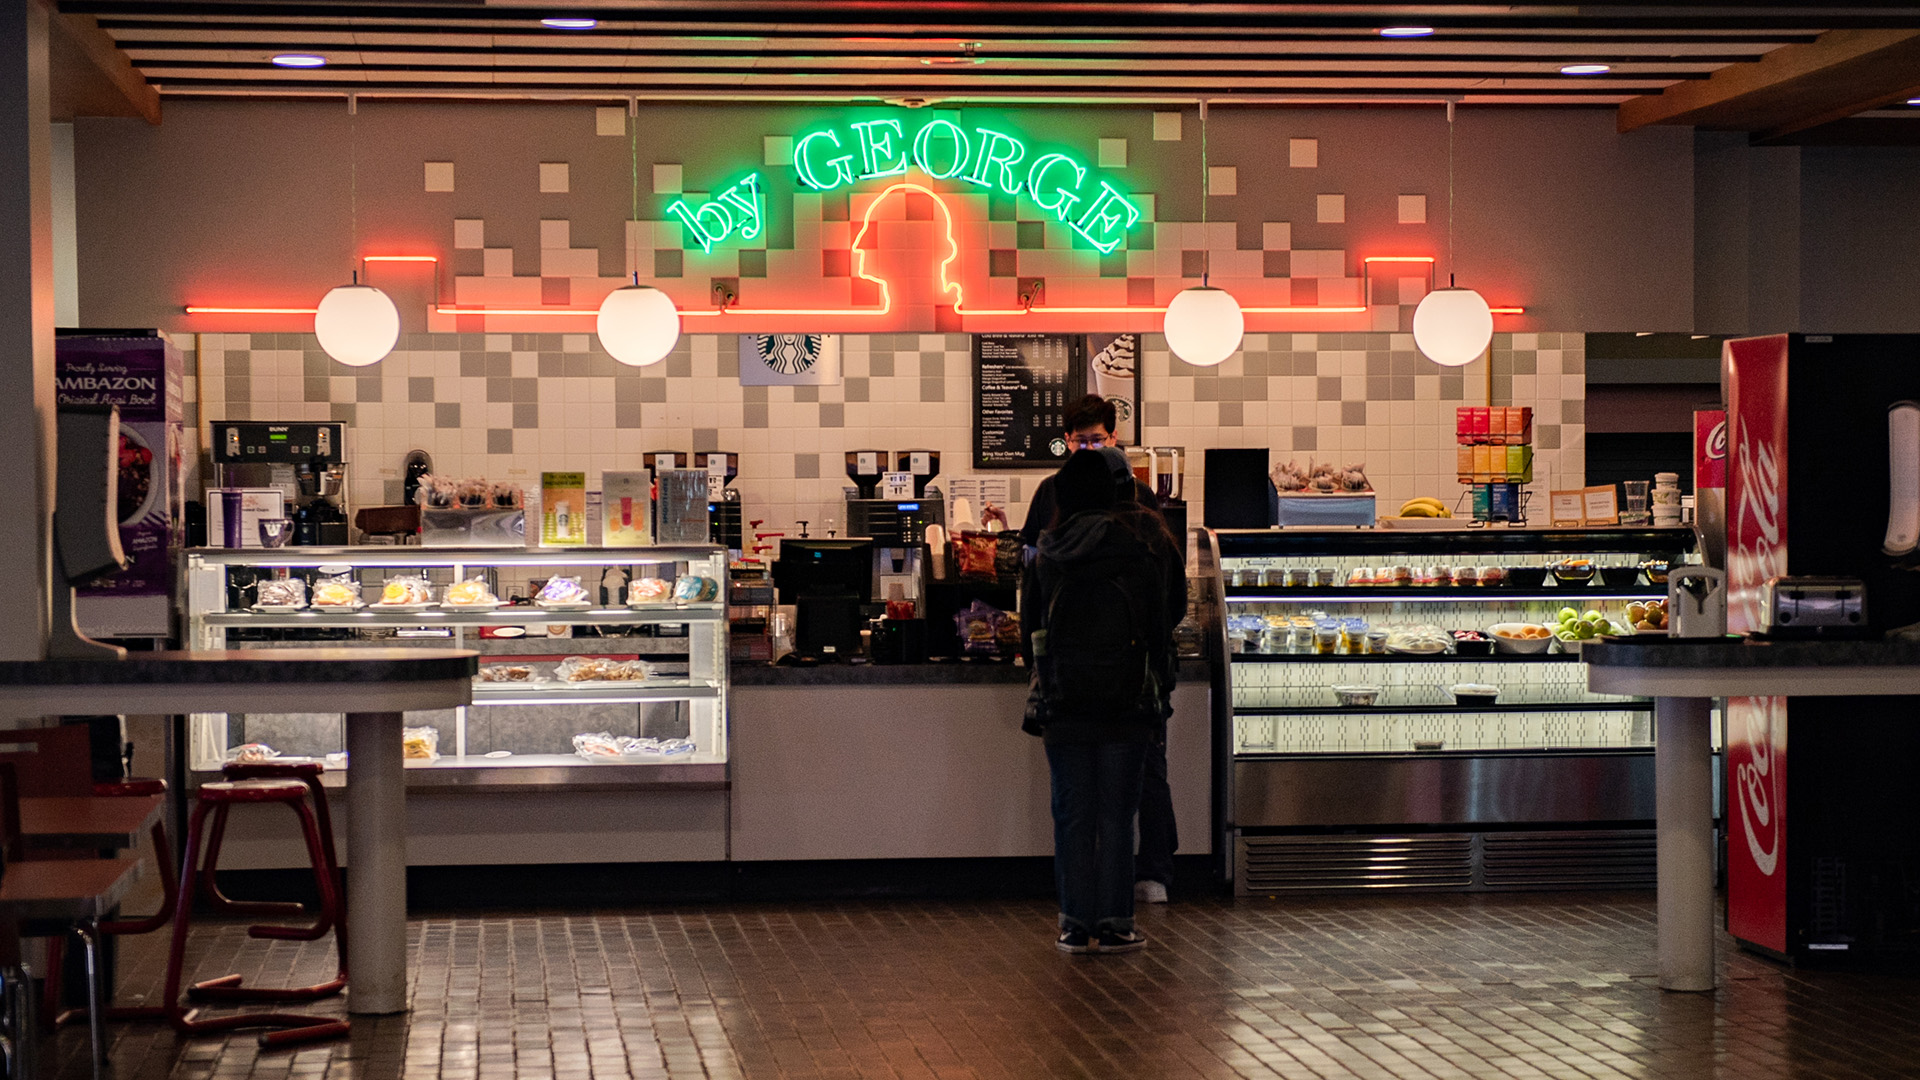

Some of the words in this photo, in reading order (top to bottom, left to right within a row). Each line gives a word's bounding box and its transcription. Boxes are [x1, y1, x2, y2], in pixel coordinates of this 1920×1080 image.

[666, 171, 759, 254] by
[792, 118, 1140, 254] GEORGE
[98, 362, 128, 375] Serving
[56, 377, 157, 390] AMBAZON
[128, 392, 157, 405] Bowl
